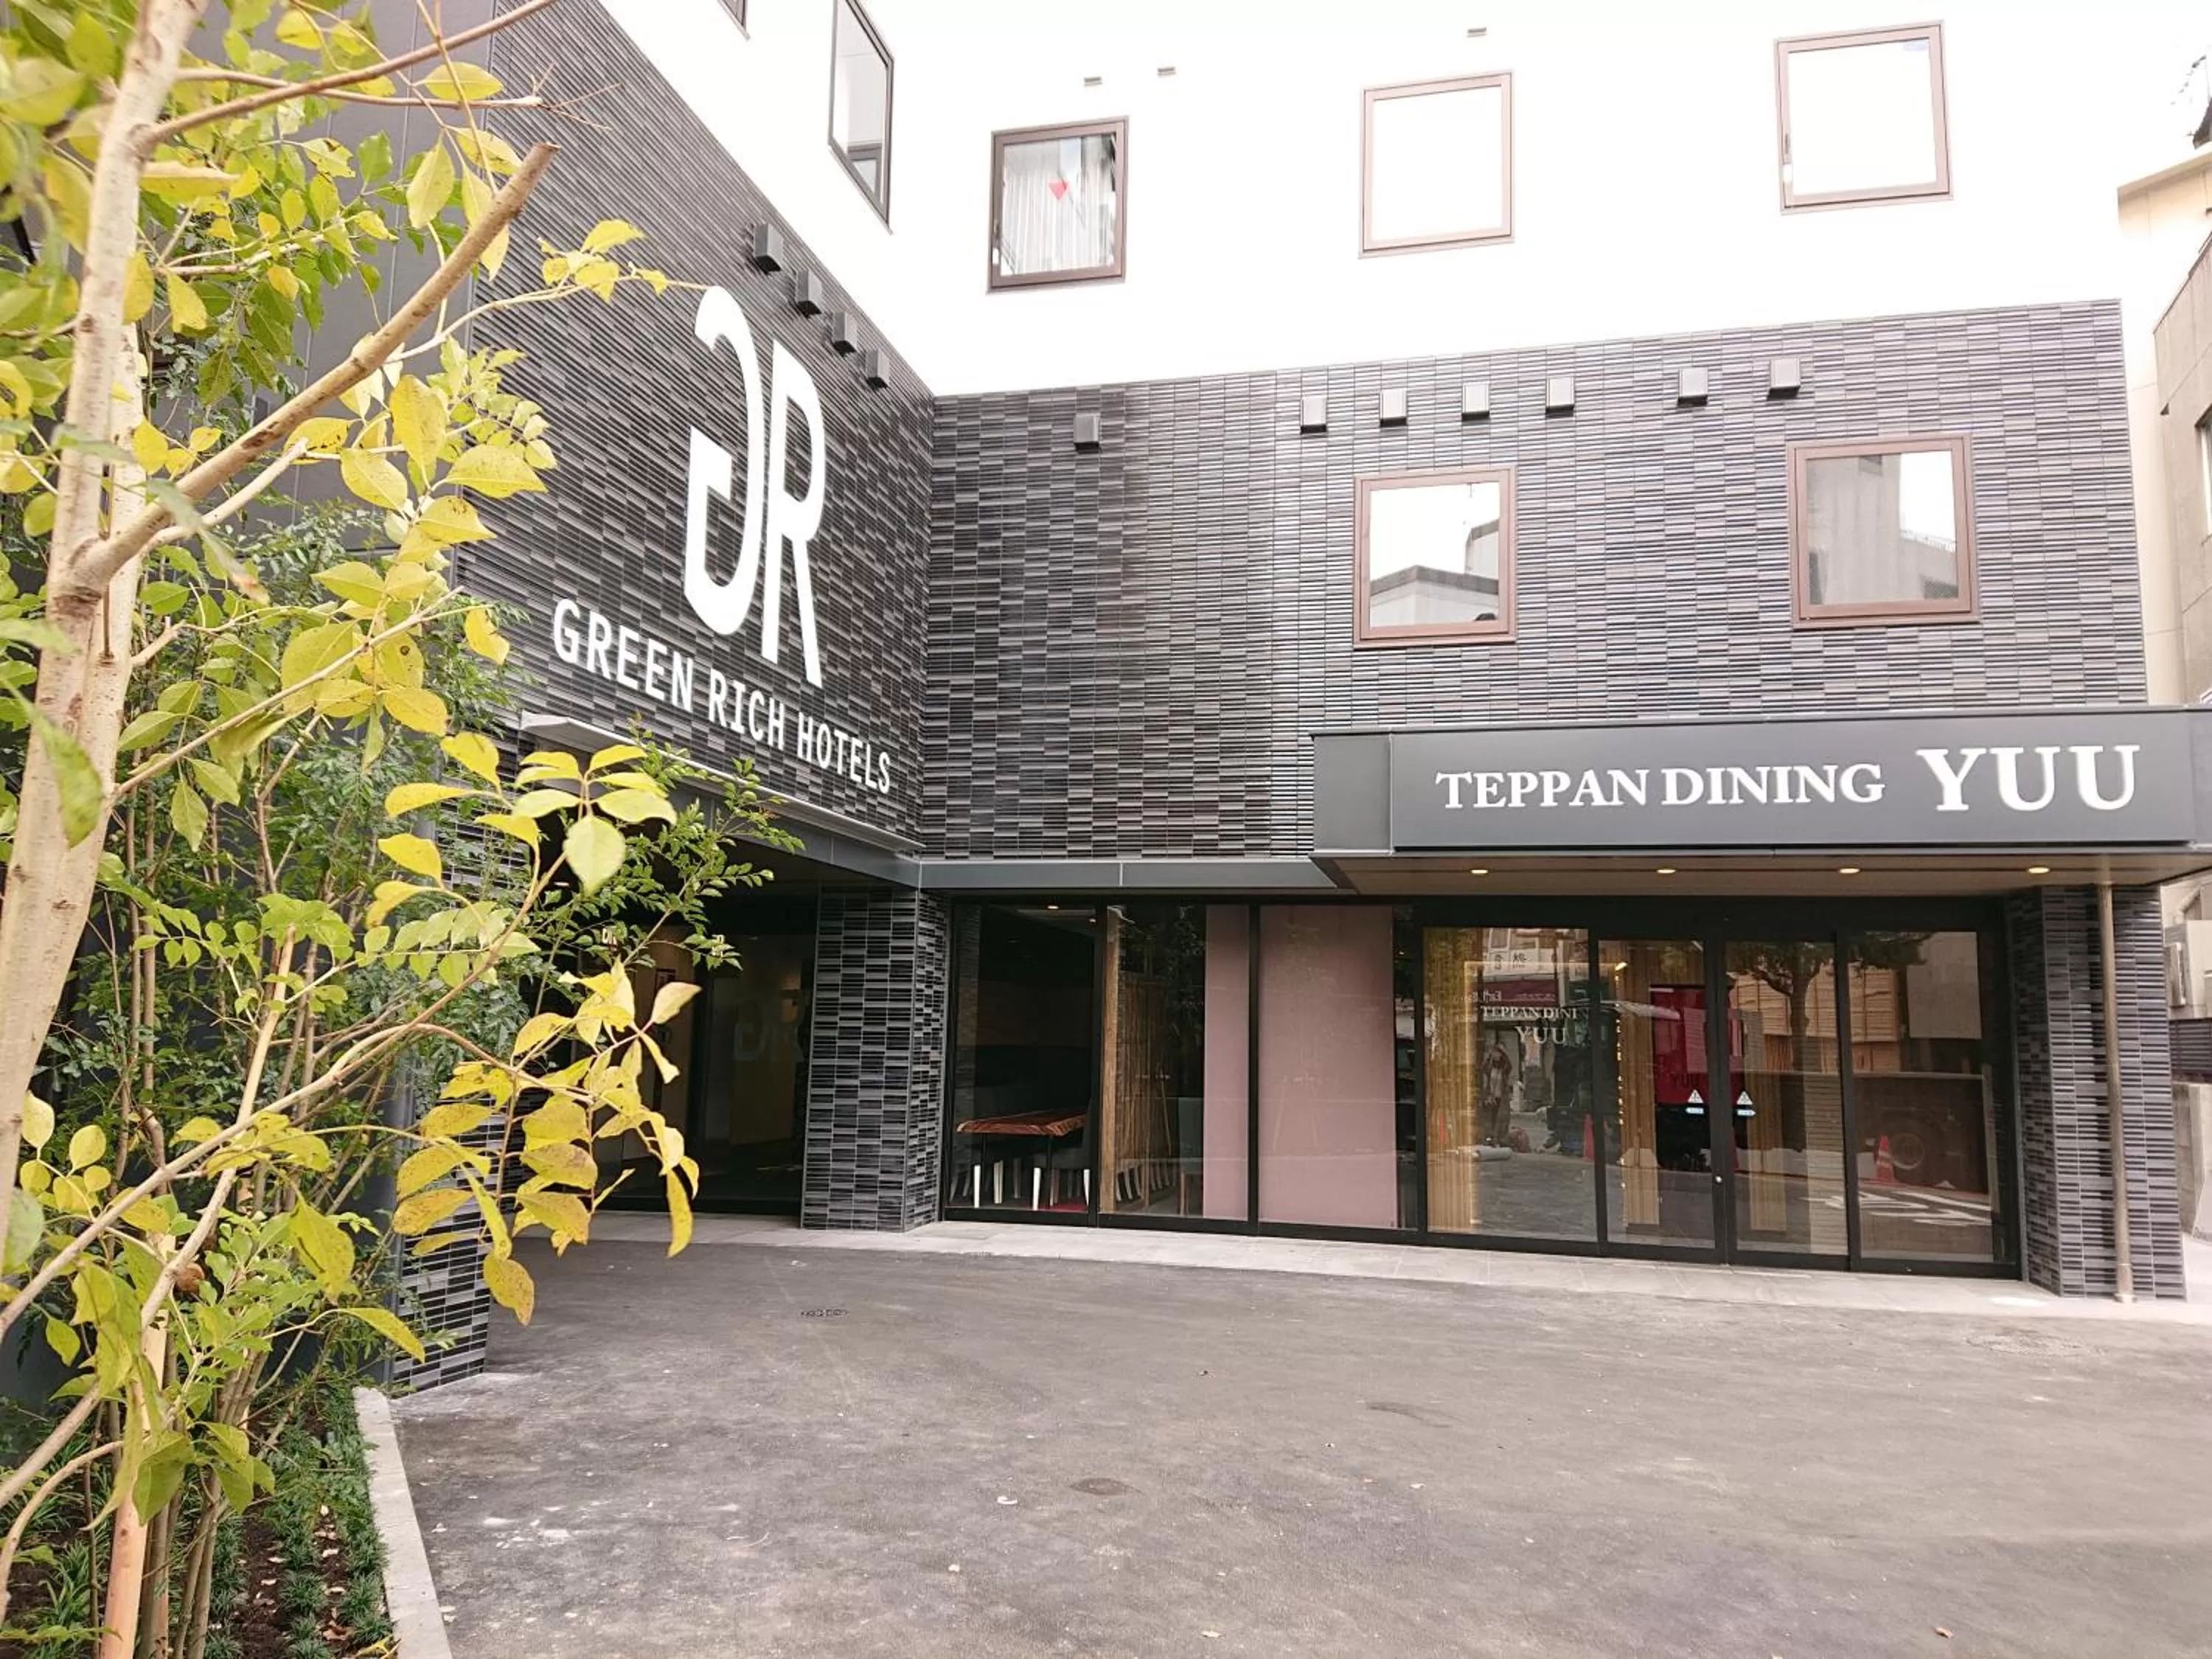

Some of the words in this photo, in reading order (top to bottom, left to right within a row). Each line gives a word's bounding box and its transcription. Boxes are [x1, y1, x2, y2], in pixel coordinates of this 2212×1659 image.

[552, 598, 695, 713] GREEN
[708, 667, 785, 751] RICH
[796, 711, 891, 794] HOTELS
[1435, 768, 1650, 810] TEPPAN
[1660, 762, 1886, 805] DINING
[1915, 744, 2141, 812] YUU
[1482, 1006, 1541, 1018] TEPPAN
[1515, 1026, 1566, 1045] YUU
